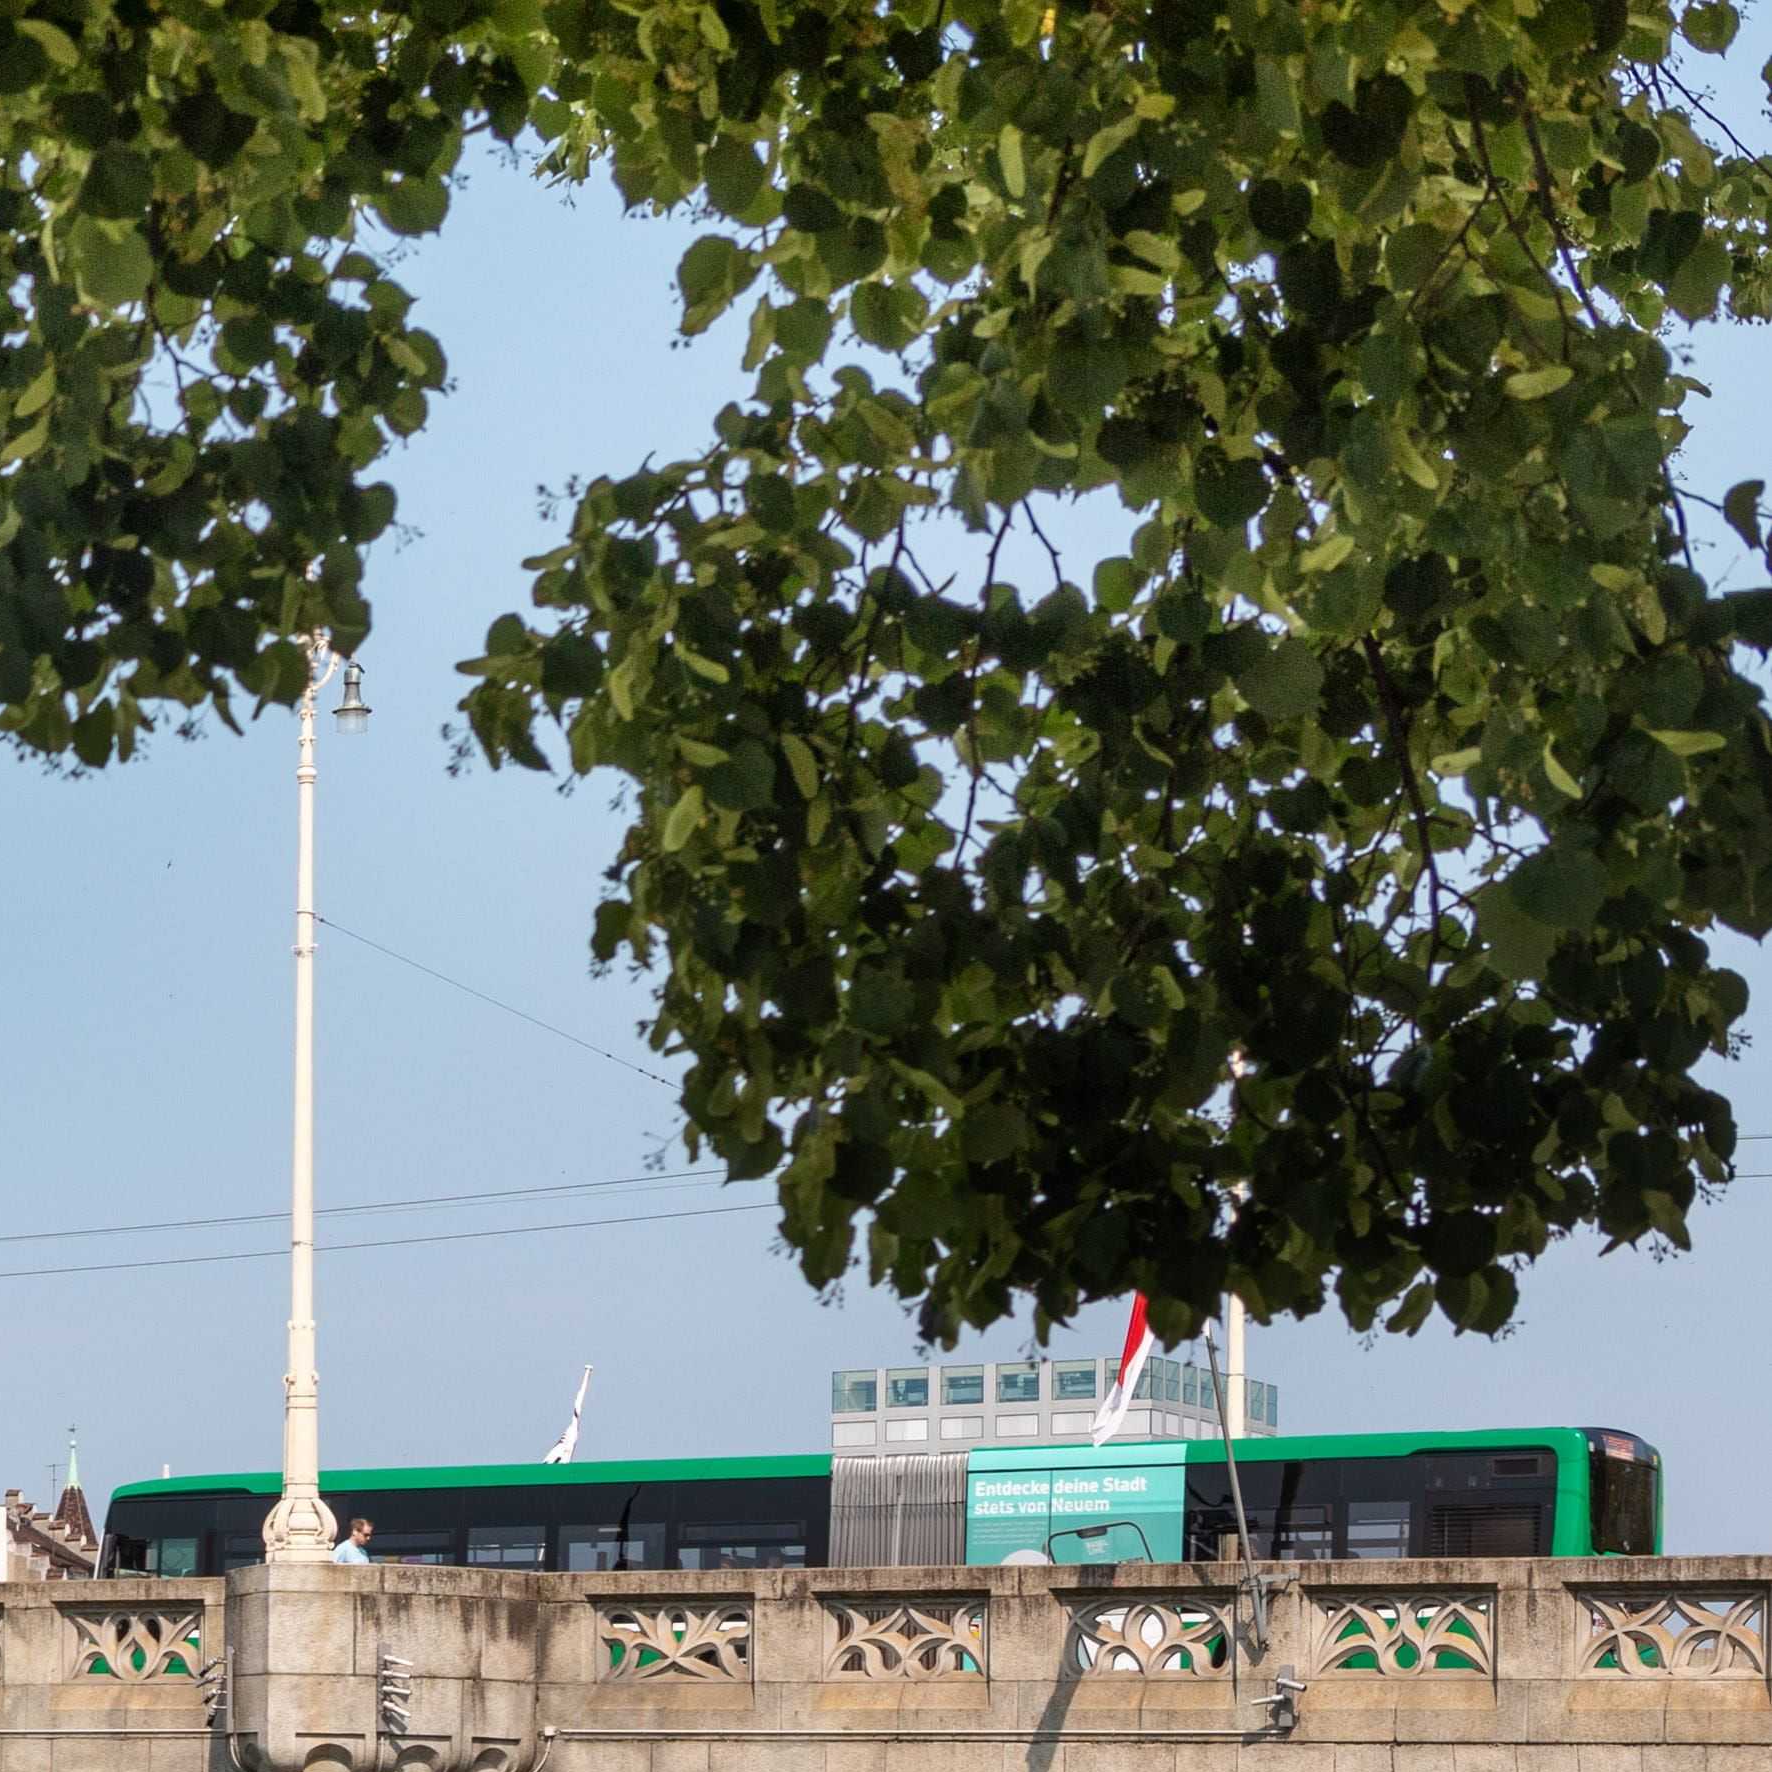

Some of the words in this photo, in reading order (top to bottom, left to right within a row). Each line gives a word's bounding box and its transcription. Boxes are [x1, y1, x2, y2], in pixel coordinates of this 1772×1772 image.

[974, 1480, 1050, 1497] Entdecke
[1053, 1478, 1099, 1494] deine
[1102, 1475, 1147, 1492] Stadt
[973, 1500, 1015, 1516] stets
[1017, 1500, 1048, 1514] von
[1051, 1497, 1111, 1513] Neuem
